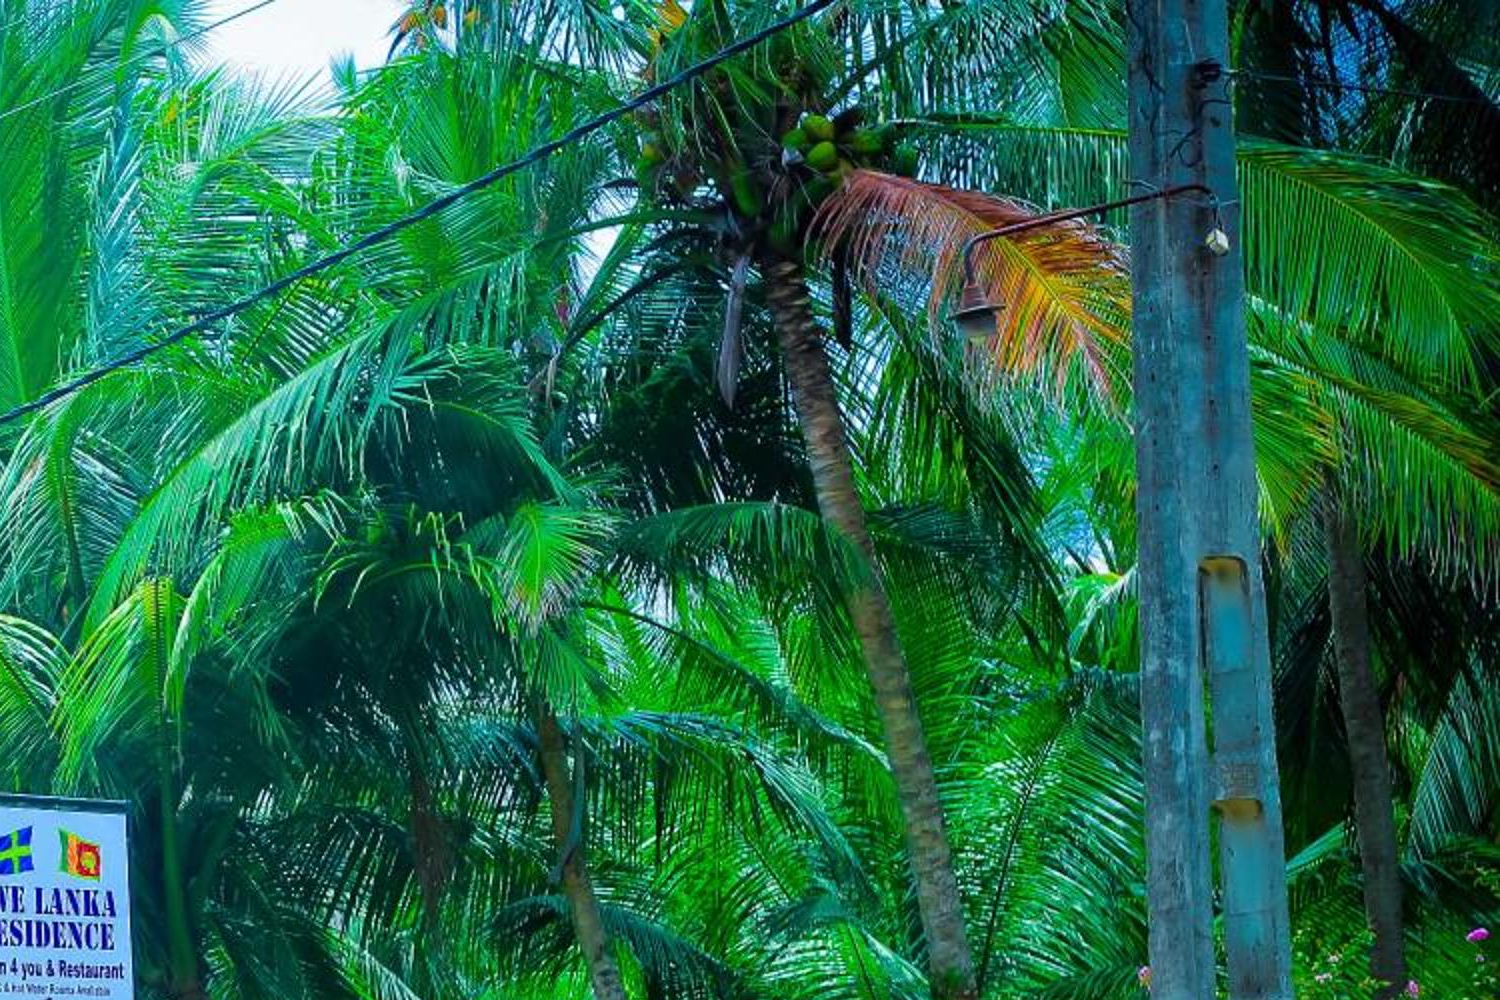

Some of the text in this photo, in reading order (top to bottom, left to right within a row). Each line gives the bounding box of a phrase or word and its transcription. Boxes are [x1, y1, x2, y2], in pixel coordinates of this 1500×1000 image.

[34, 887, 117, 917] LANKA
[10, 957, 18, 975] 4
[22, 961, 42, 981] you
[46, 959, 55, 976] &
[59, 960, 125, 979] Restaurant
